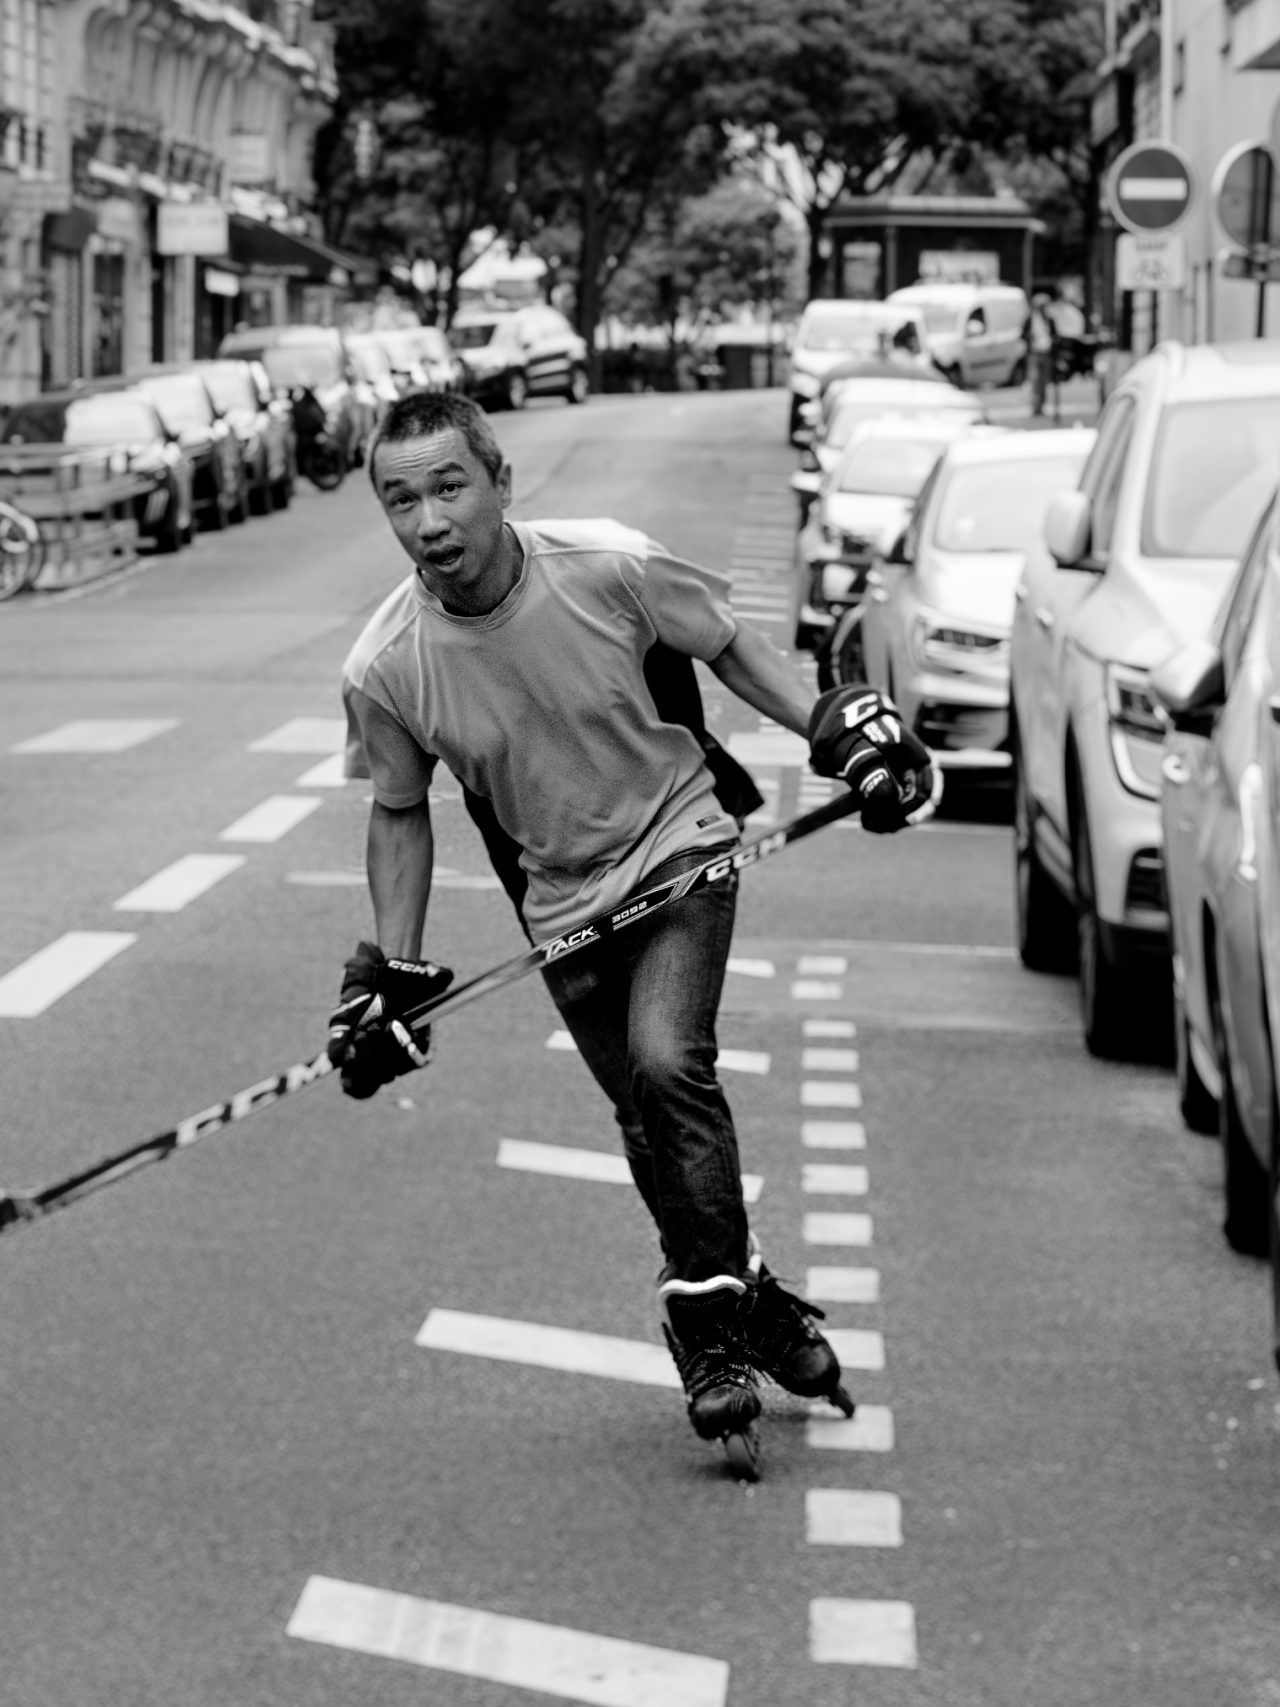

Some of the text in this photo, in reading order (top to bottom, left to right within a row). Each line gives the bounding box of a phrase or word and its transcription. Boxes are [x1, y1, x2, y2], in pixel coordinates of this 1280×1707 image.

[705, 829, 787, 882] CCM
[387, 959, 427, 976] CCM
[176, 1051, 334, 1147] CCM
